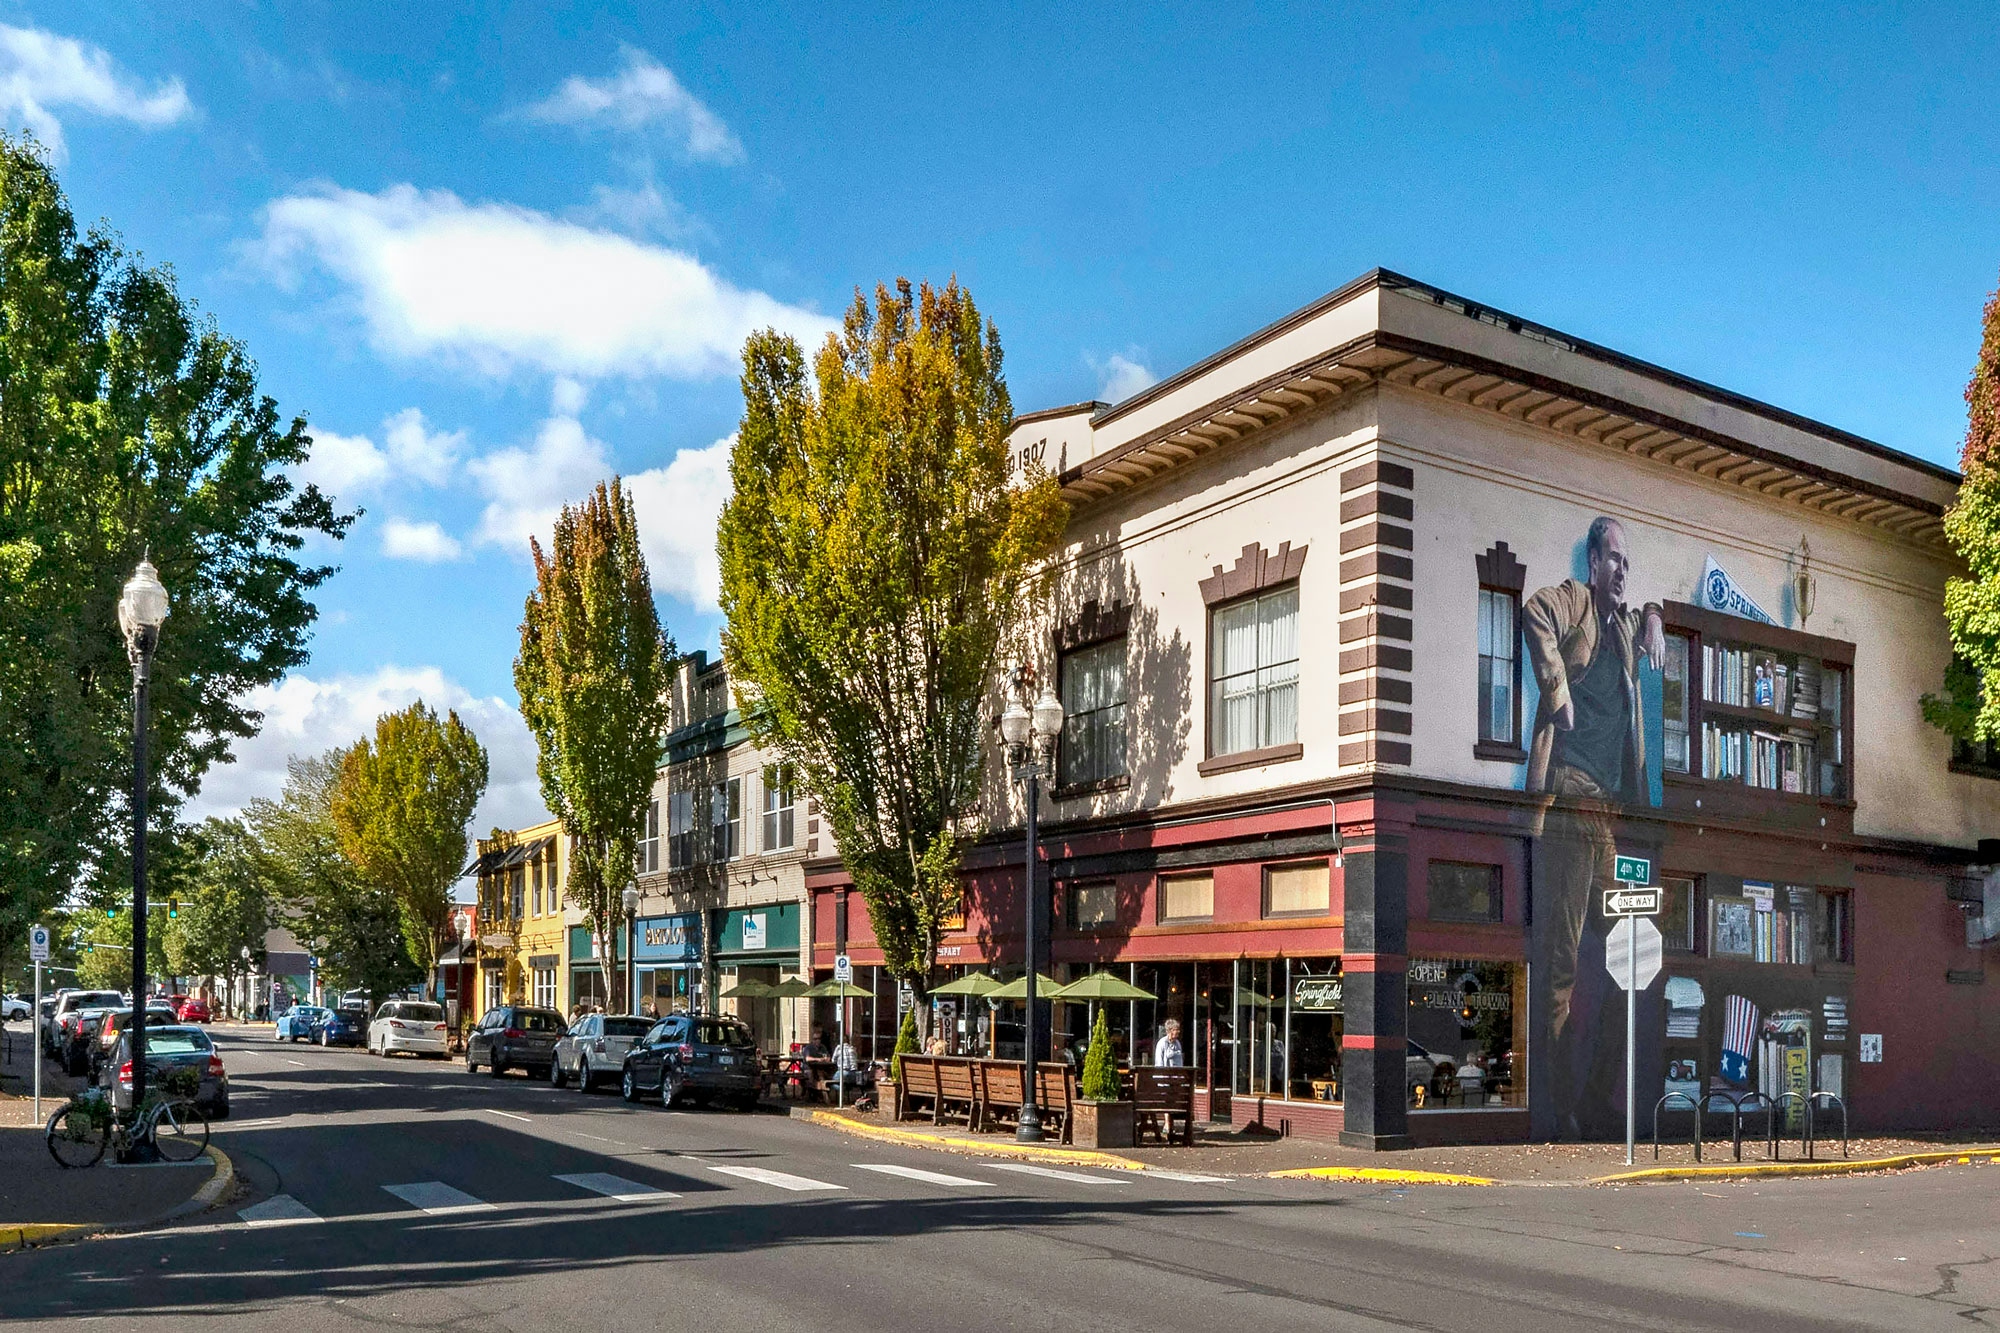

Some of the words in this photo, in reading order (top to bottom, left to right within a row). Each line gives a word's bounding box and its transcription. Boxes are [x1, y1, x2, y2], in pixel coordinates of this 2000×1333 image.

[1019, 437, 1047, 470] 1907
[1620, 862, 1633, 876] 4th
[1636, 864, 1645, 878] St
[1618, 897, 1633, 907] ONE
[1636, 896, 1652, 906] WAY
[1414, 966, 1441, 982] OPEN
[1295, 979, 1342, 1007] Springfield
[1426, 990, 1467, 1009] PLANK
[1471, 992, 1510, 1010] TOWN
